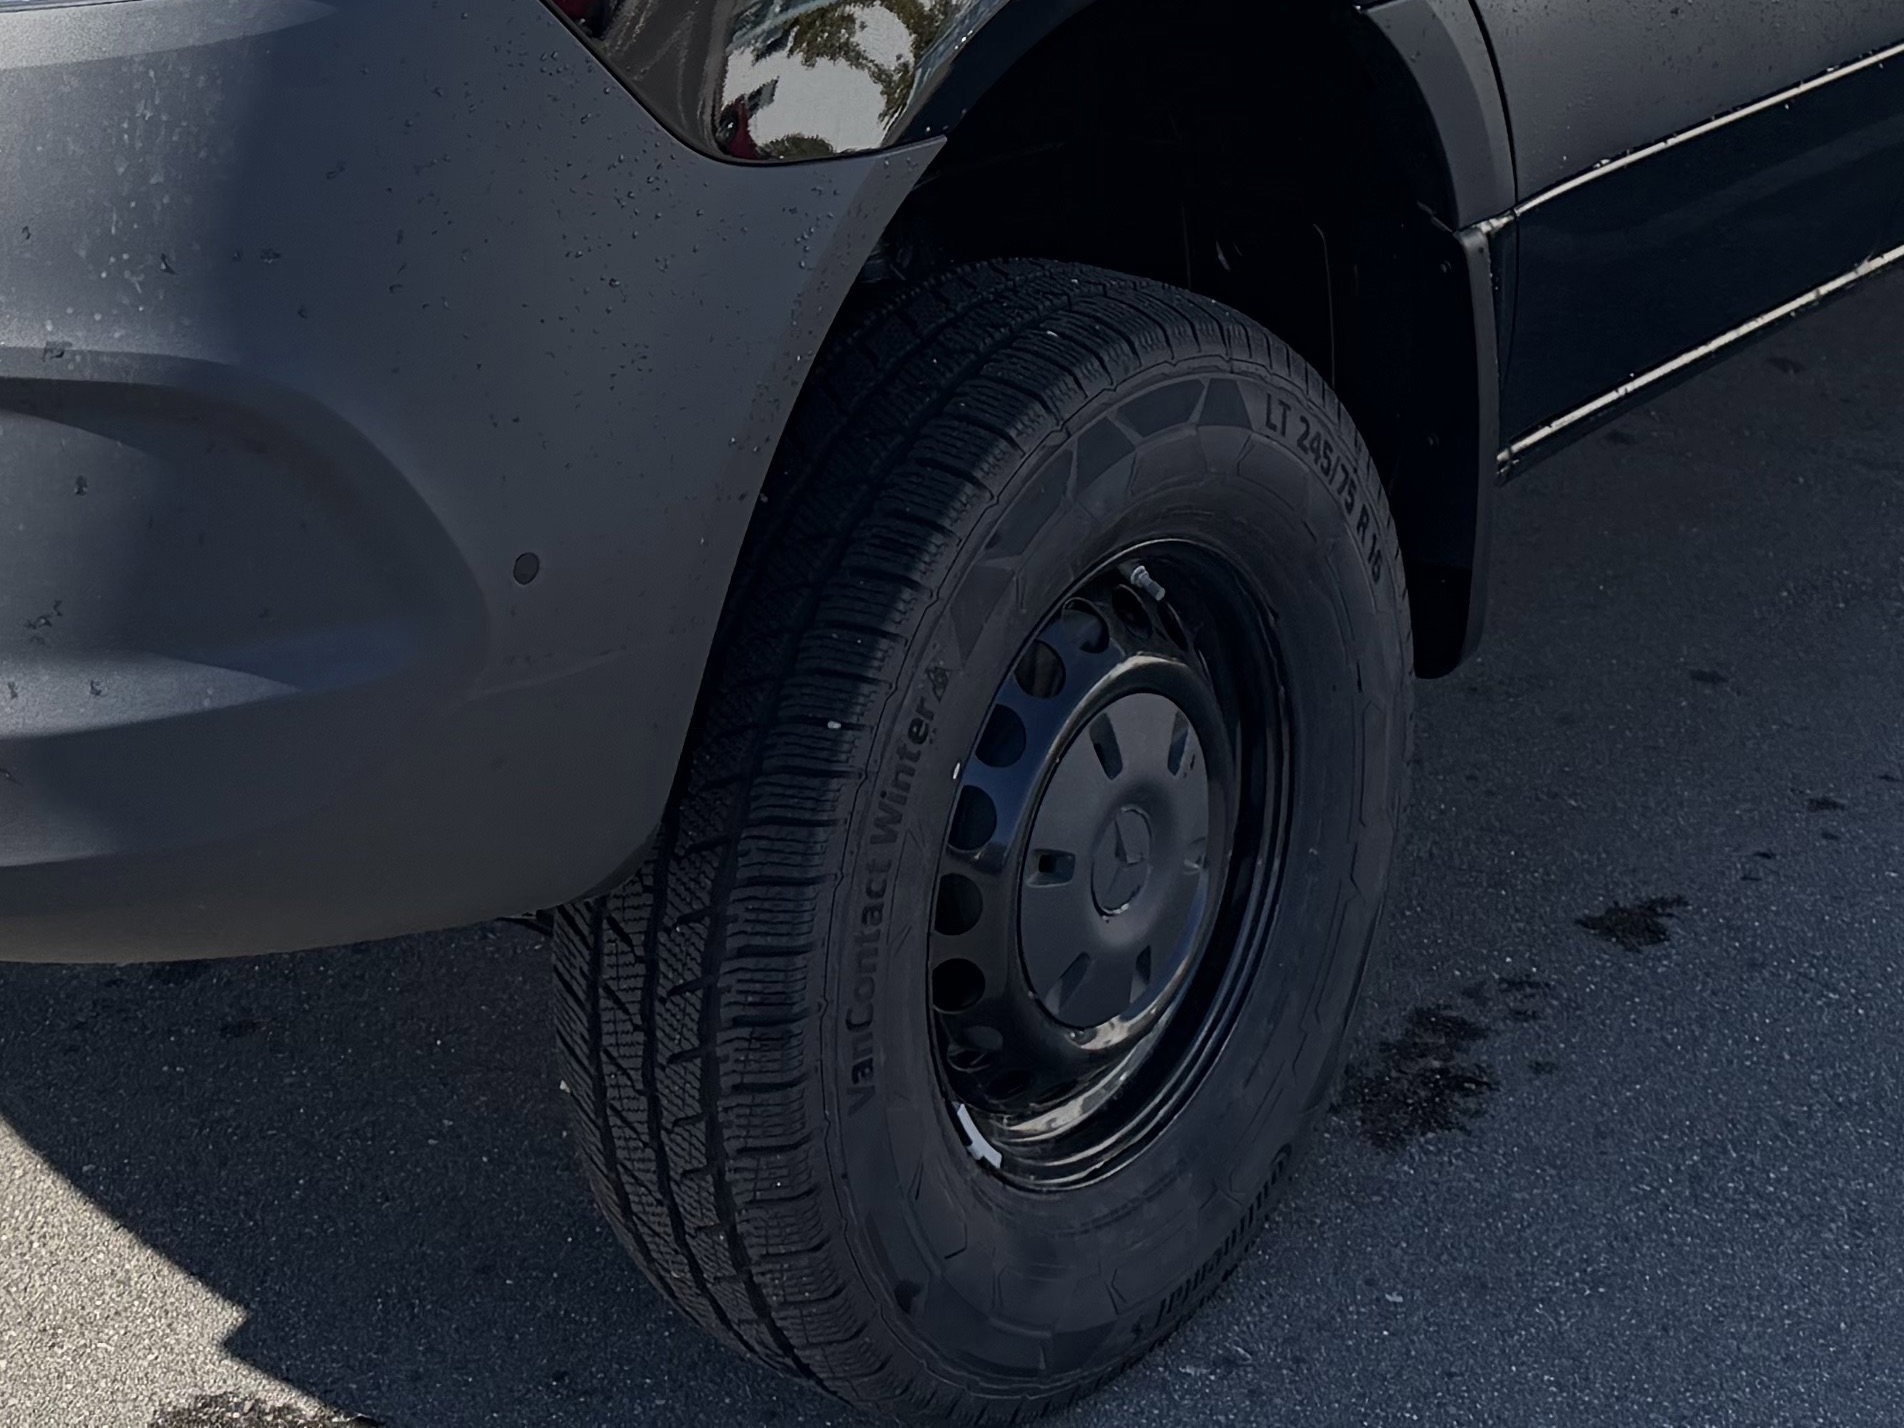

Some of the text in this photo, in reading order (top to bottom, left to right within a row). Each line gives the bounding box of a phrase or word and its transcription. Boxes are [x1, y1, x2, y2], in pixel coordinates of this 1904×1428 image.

[1265, 392, 1293, 438] LT
[1296, 415, 1359, 516] 245/75
[1356, 503, 1371, 546] R
[844, 695, 938, 1117] VanContact Winter
